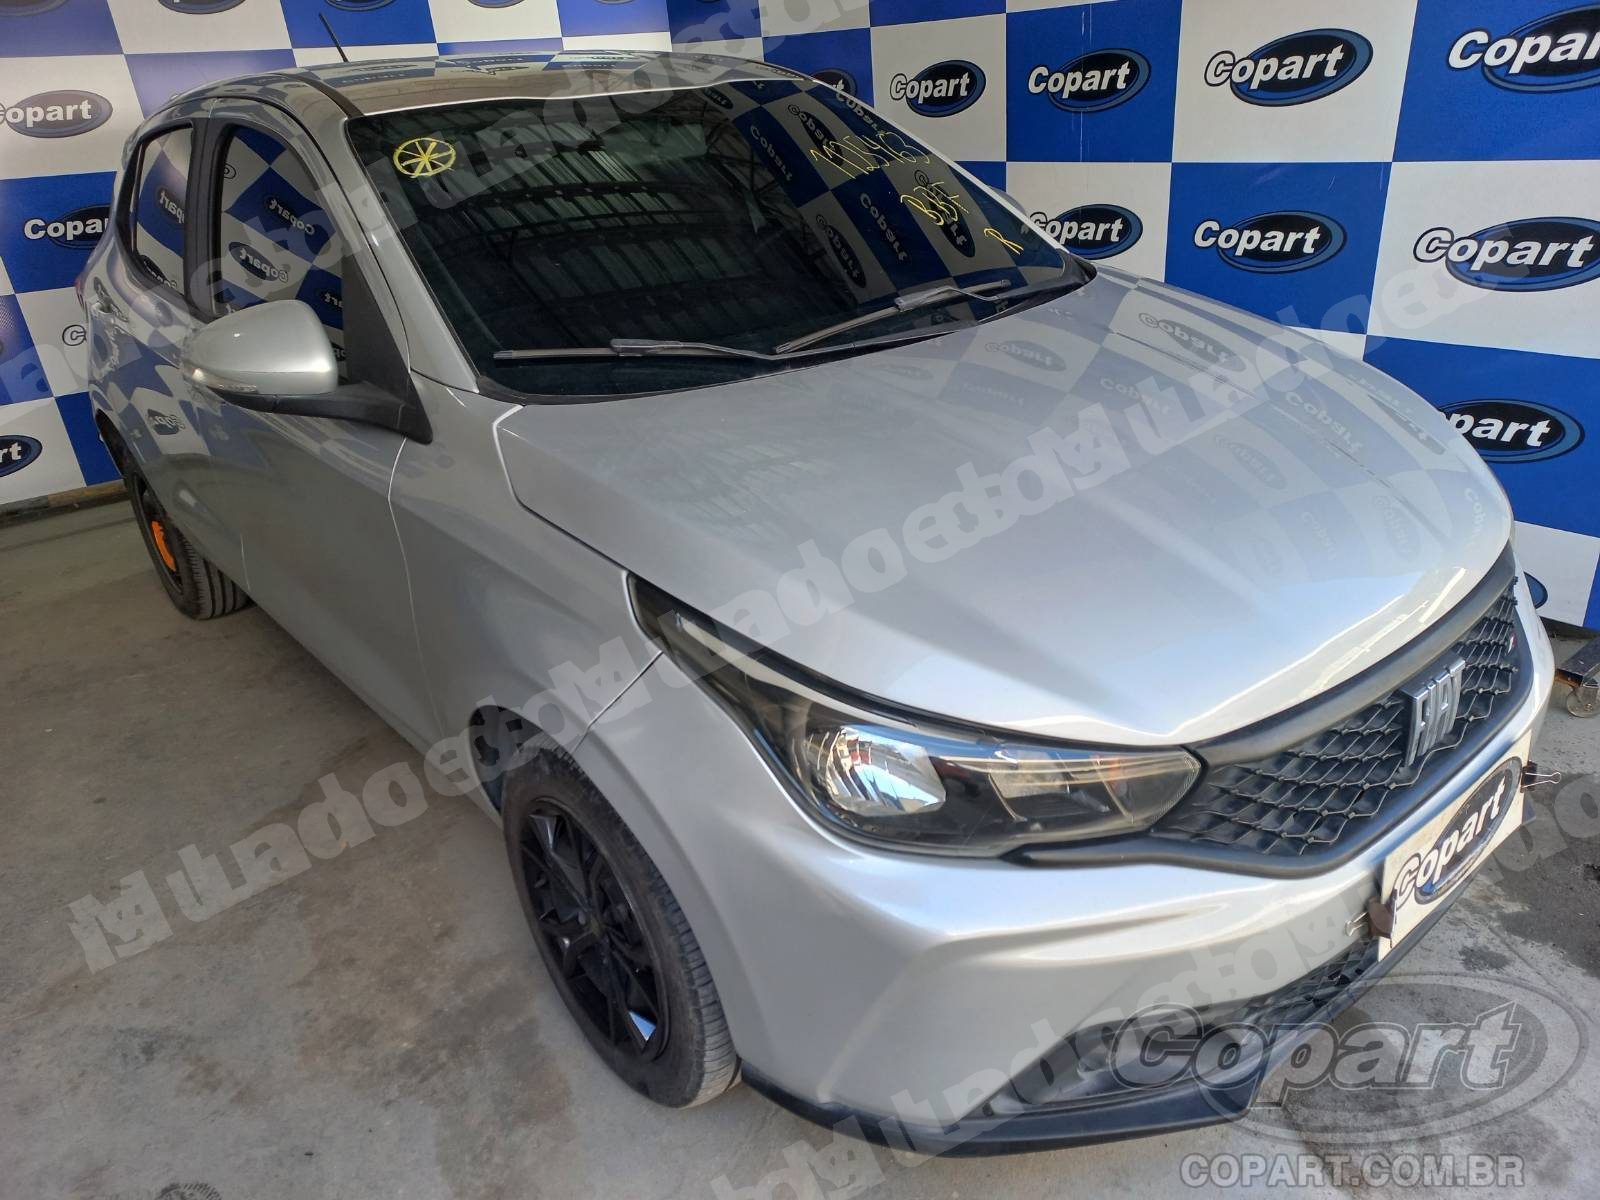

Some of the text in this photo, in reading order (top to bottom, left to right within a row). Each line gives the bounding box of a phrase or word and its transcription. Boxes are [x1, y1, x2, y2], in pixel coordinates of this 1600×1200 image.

[1204, 43, 1343, 90] Copart
[1448, 30, 1600, 74] Copar
[889, 72, 970, 104] Copart
[1028, 60, 1130, 99] Copart
[1194, 220, 1321, 257] Copart
[1413, 227, 1594, 271] Copart
[1441, 411, 1551, 447] part
[1393, 775, 1506, 911] Copart
